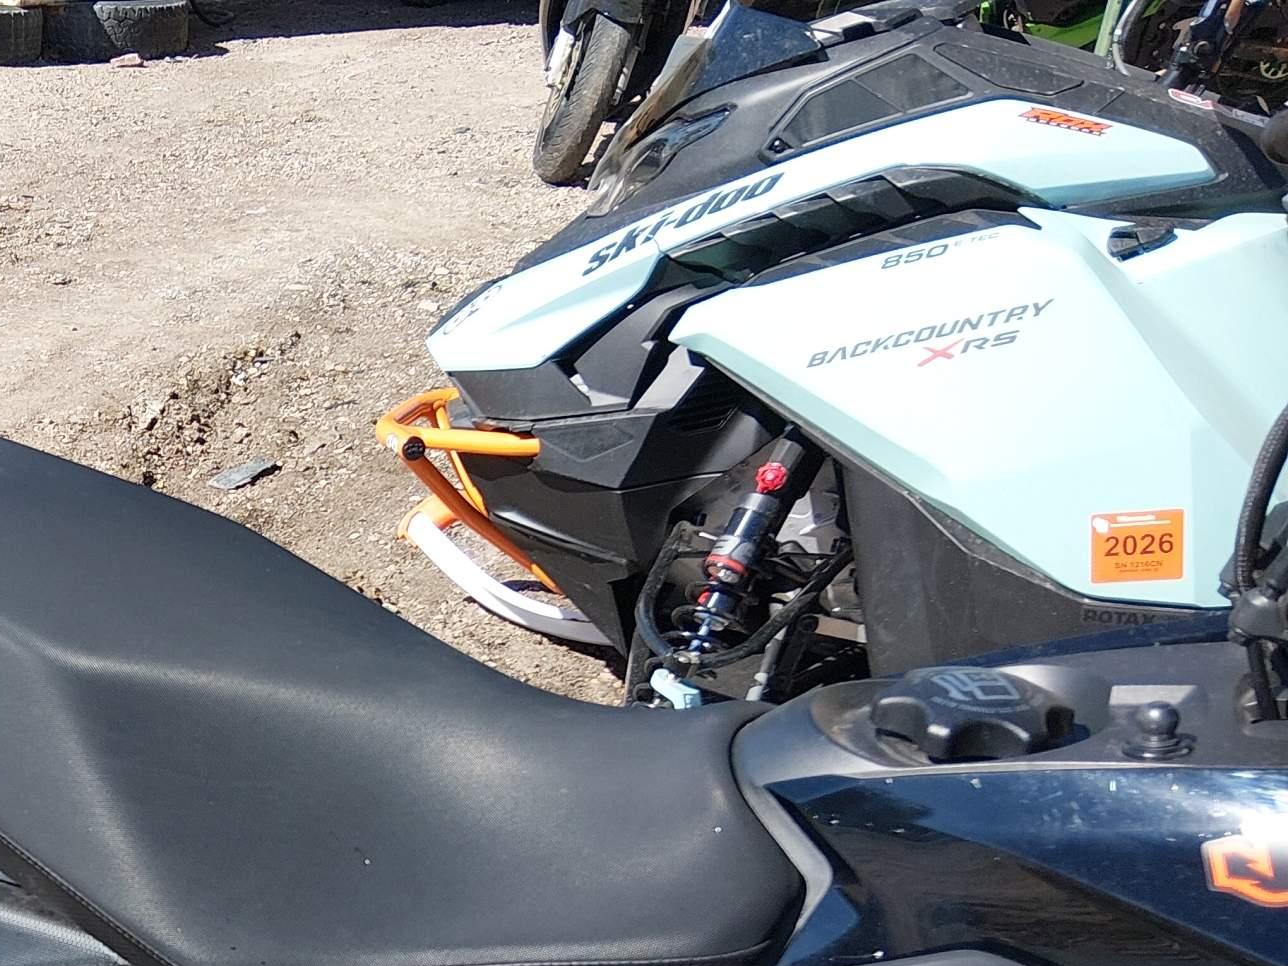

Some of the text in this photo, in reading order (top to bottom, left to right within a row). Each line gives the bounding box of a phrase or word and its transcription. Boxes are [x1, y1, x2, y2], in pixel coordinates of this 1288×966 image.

[881, 243, 949, 269] 850
[806, 298, 1055, 368] BACKCOUNTRY
[917, 330, 1021, 367] XRS
[1104, 533, 1173, 557] 2026
